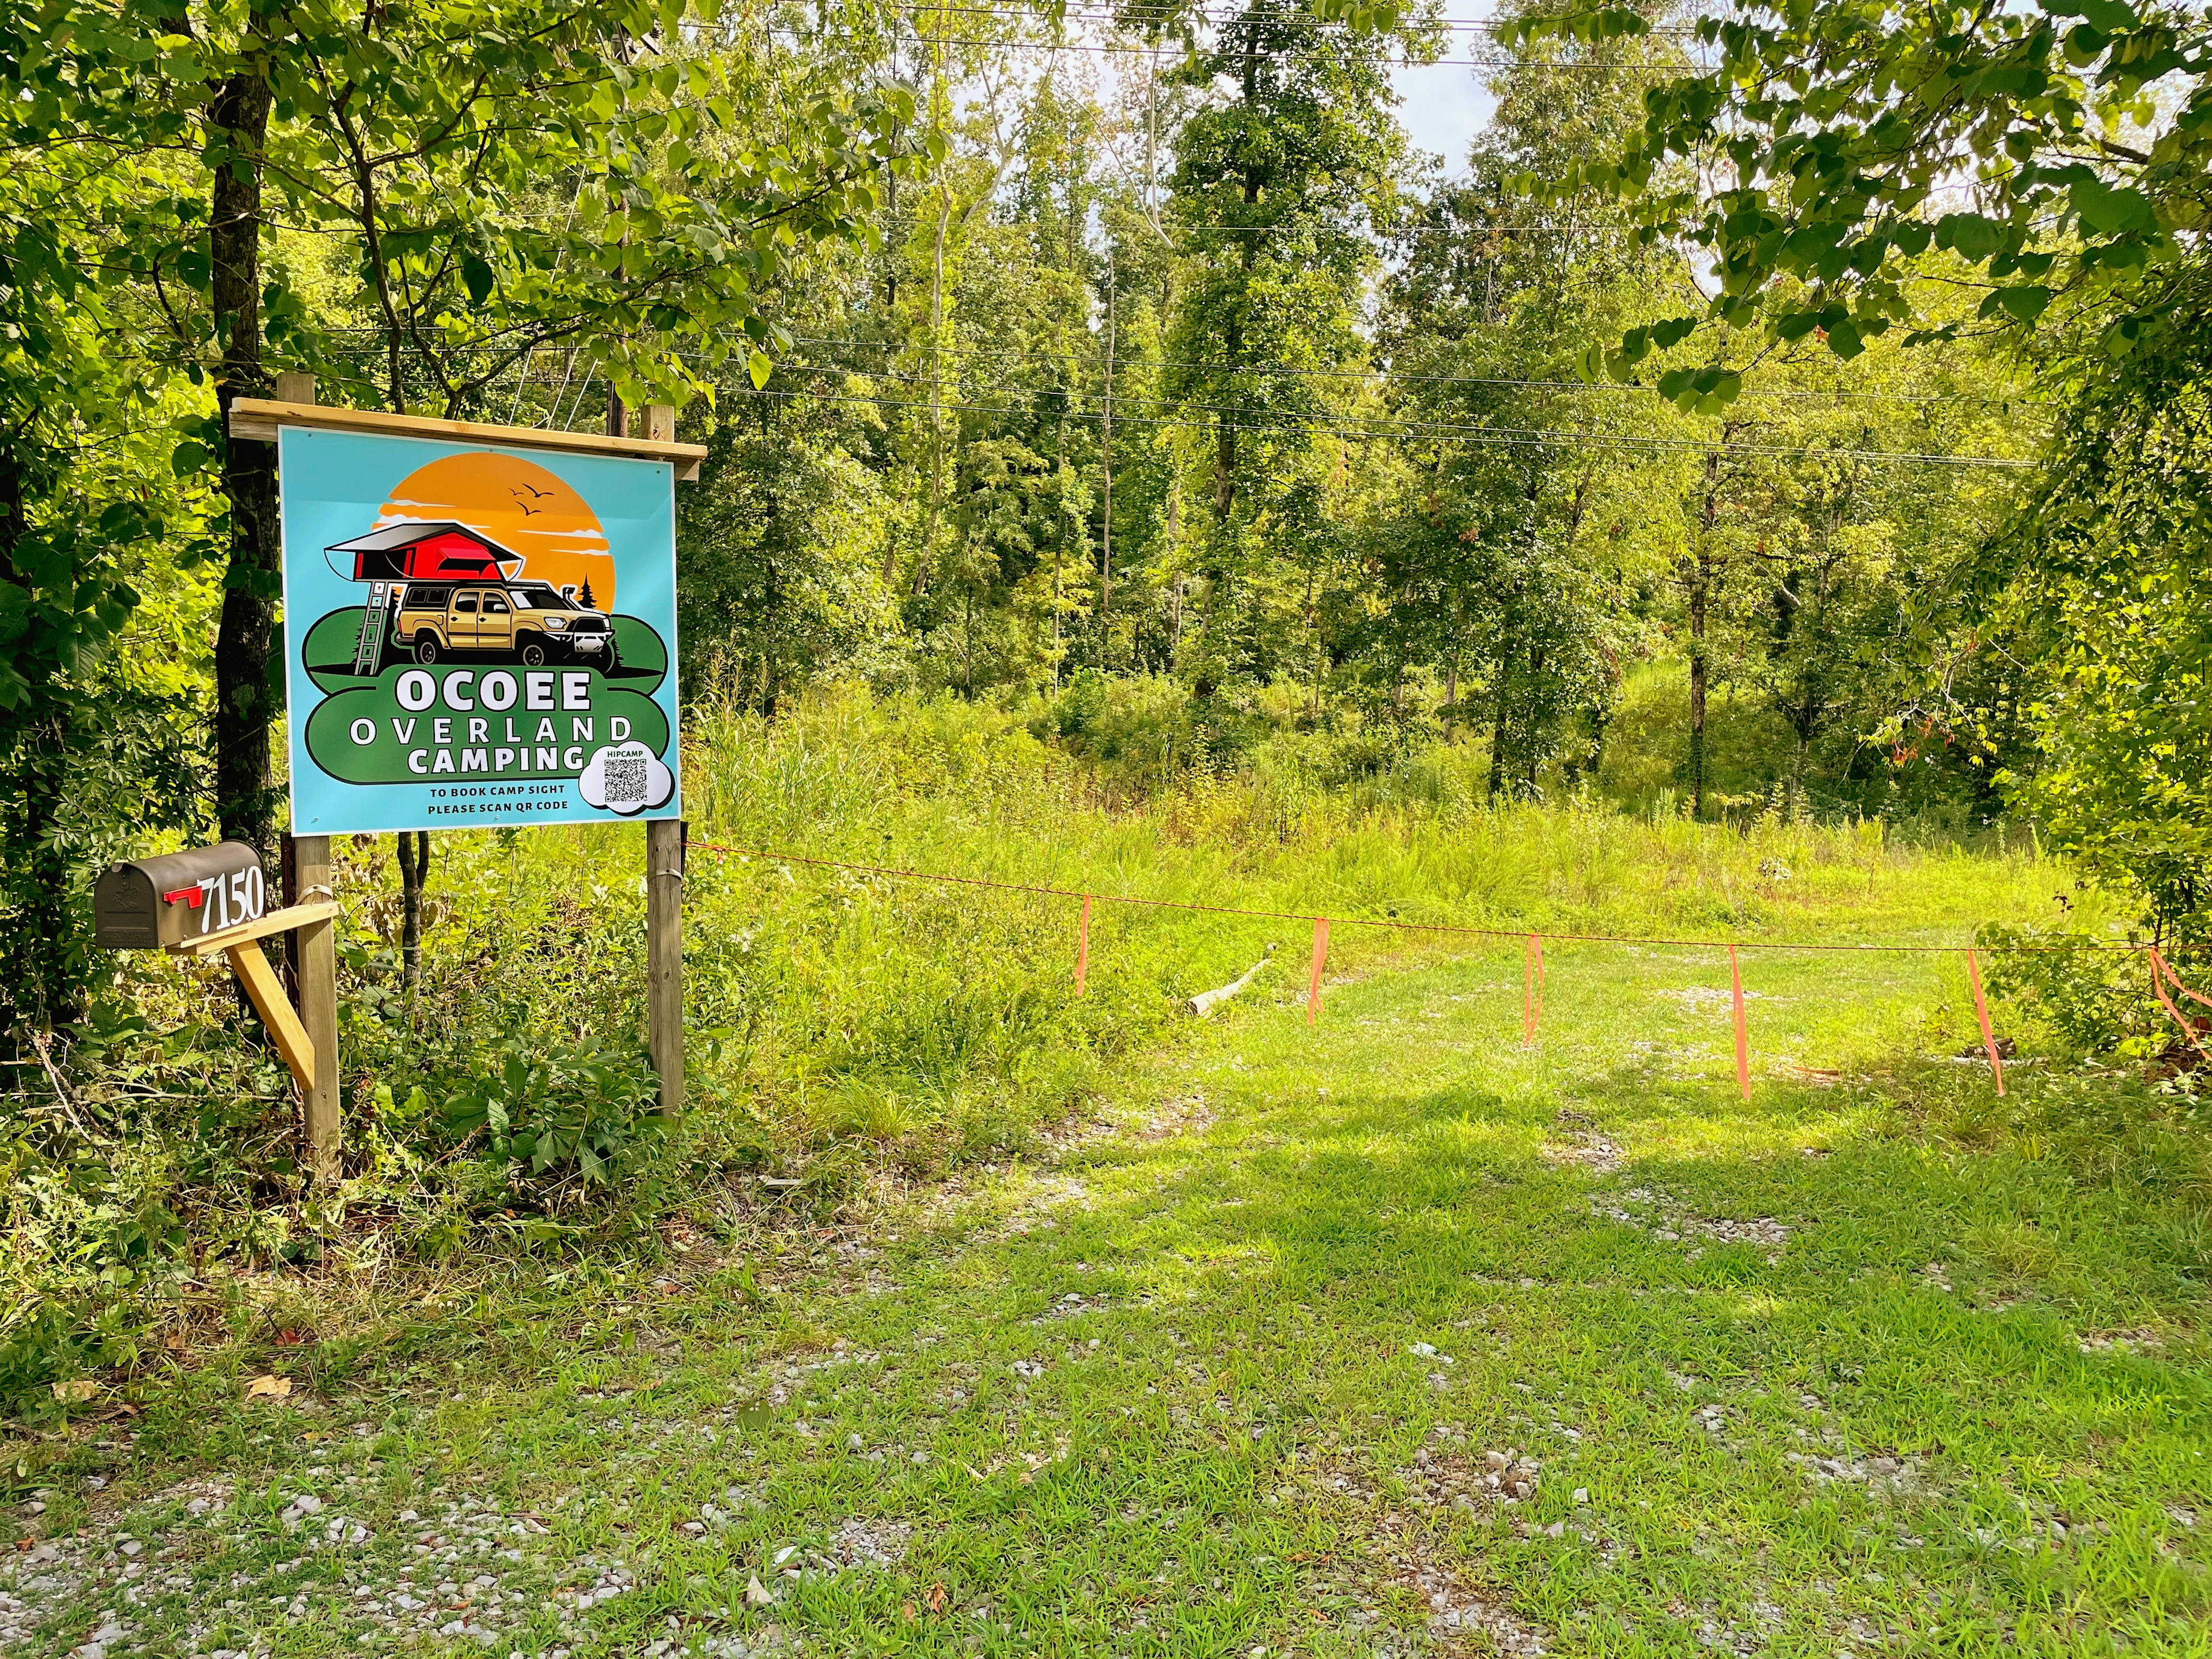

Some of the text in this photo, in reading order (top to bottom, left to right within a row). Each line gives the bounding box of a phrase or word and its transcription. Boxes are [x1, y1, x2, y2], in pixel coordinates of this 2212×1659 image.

[396, 671, 592, 711] OCOEE
[350, 717, 632, 745] OVERLAND
[408, 747, 584, 774] CAMPING
[430, 785, 565, 797] TO BOOK CAMP SIGHT
[428, 801, 568, 814] PLEASE SCAN QR CODE
[197, 865, 264, 934] 7150
